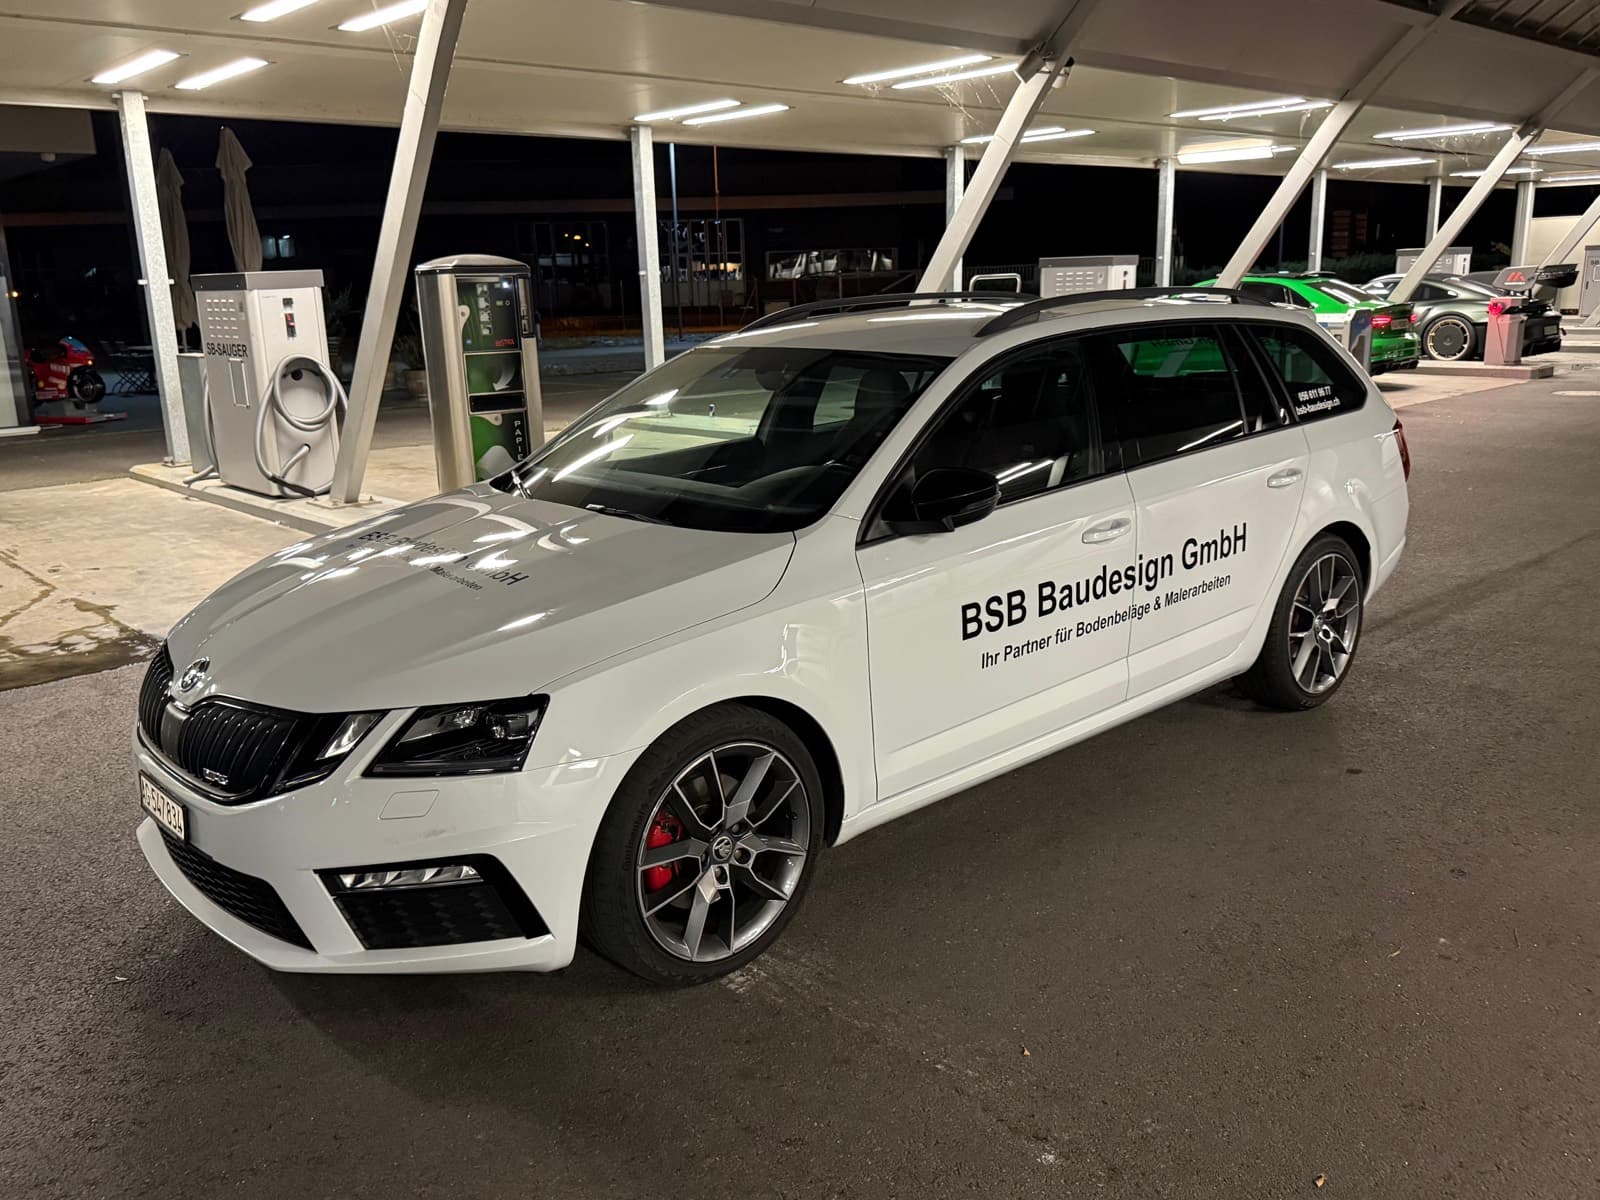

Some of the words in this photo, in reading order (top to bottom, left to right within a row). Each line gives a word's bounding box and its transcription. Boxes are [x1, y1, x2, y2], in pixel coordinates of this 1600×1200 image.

[206, 342, 249, 358] SB-SAUGER
[961, 589, 1027, 641] BSB
[1038, 552, 1174, 618] Baudesign
[1181, 522, 1247, 570] GmbH
[981, 650, 999, 669] Ihr
[1004, 635, 1052, 662] Partner
[1054, 625, 1073, 644] für
[1075, 602, 1151, 638] Bodenbeläge
[1153, 598, 1162, 611] &
[1164, 574, 1231, 608] Malerarbeiten
